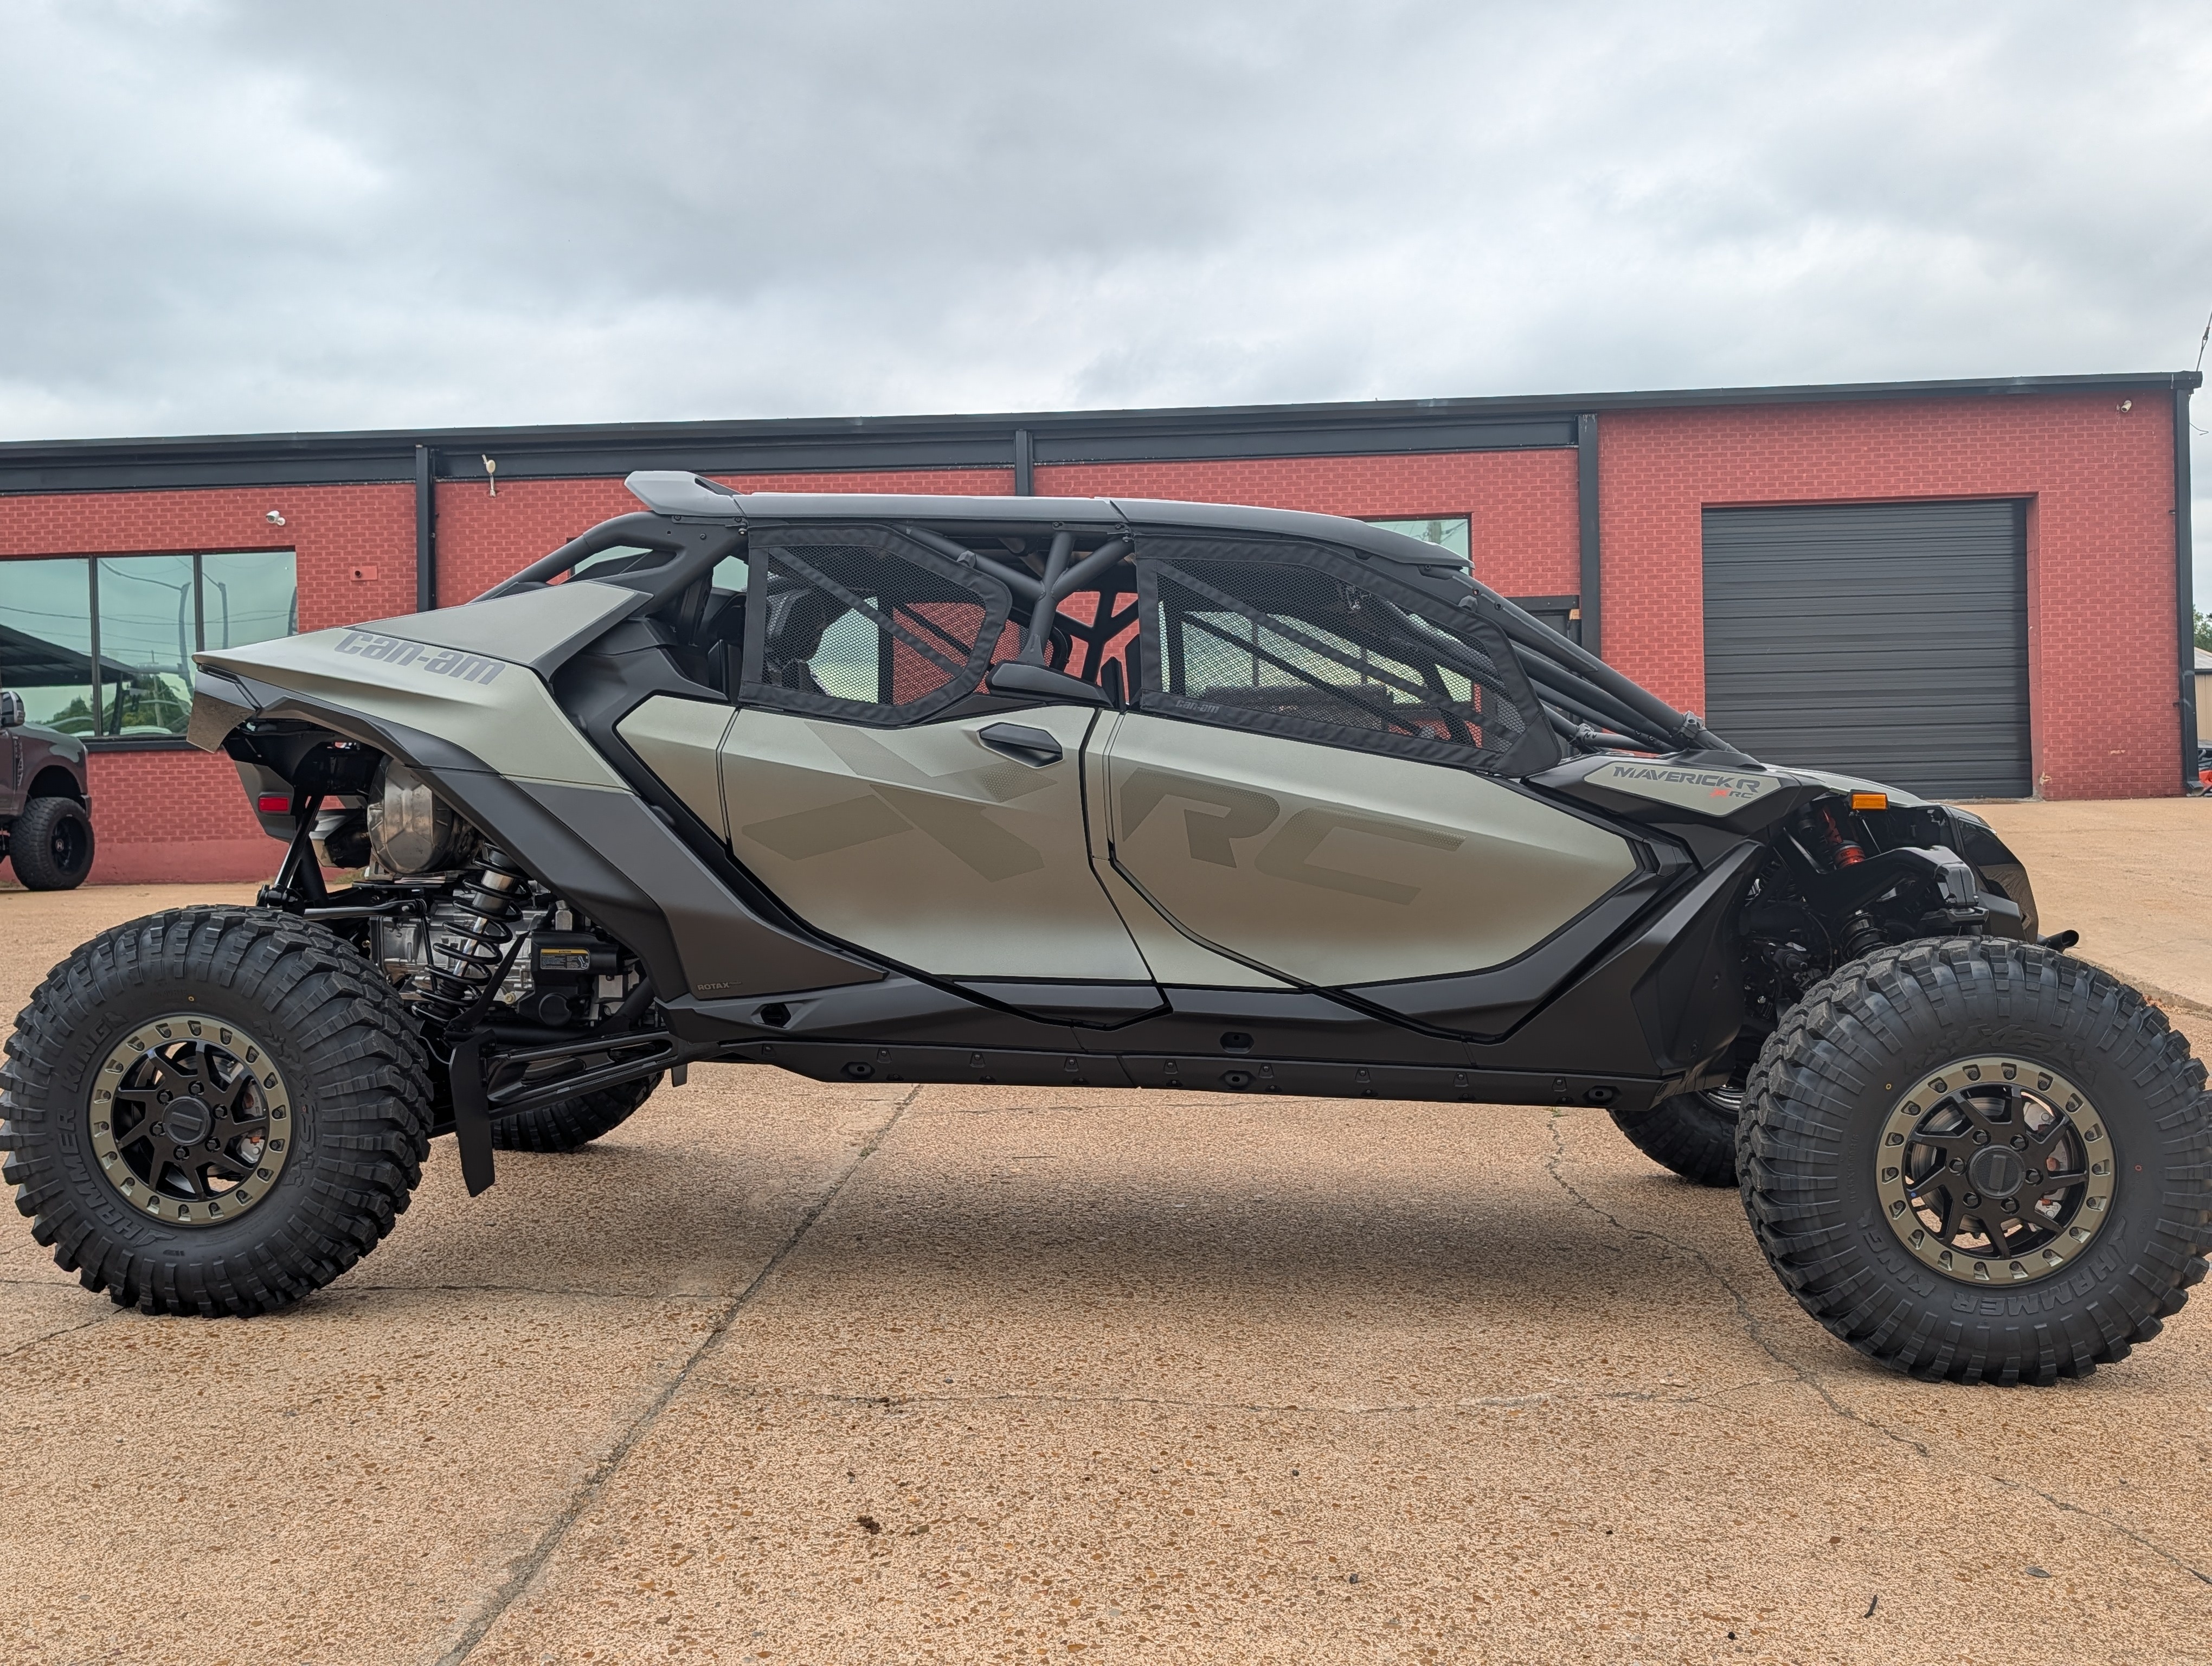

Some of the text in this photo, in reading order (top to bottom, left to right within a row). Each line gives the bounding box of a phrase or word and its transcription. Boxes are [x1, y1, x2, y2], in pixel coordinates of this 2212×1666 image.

[335, 632, 506, 685] can-am
[1175, 700, 1220, 713] can-am
[1613, 766, 1760, 793] MAVERICK R
[697, 982, 730, 991] ROTAX
[57, 1018, 144, 1240] HAMMER KING
[1863, 1230, 2118, 1316] HAMMER KING
